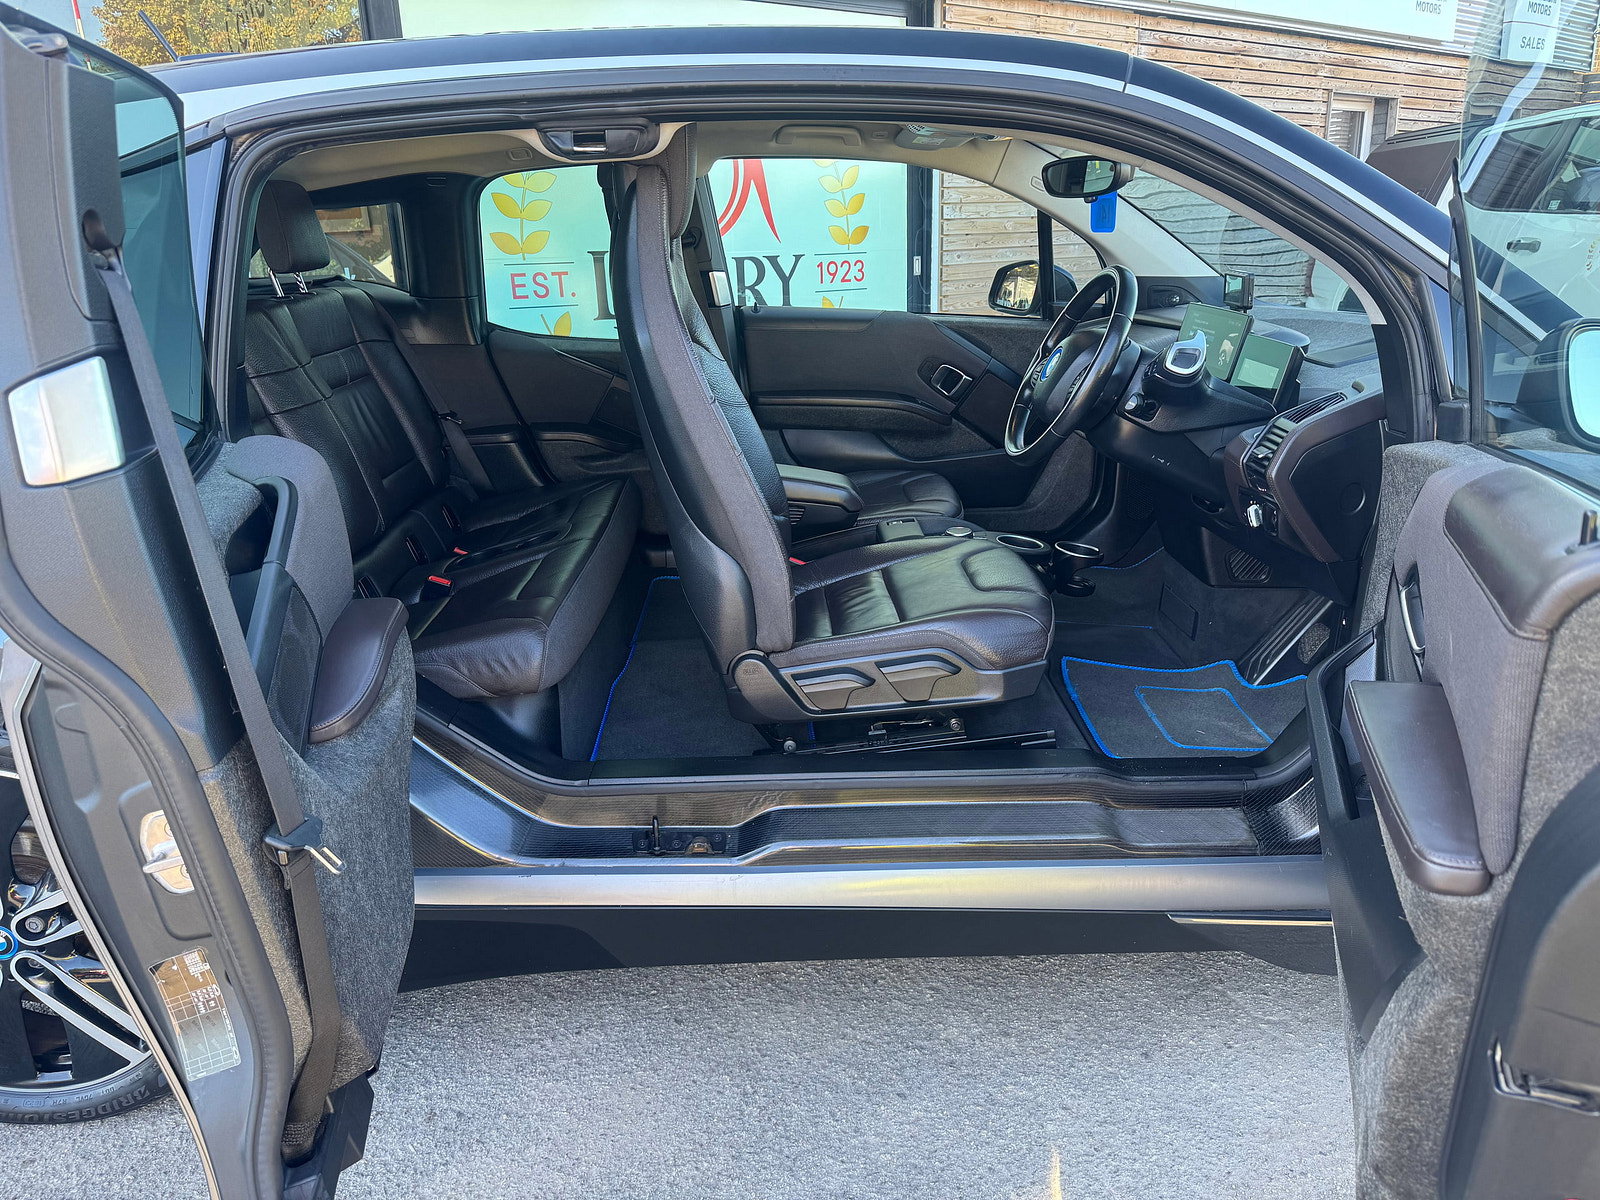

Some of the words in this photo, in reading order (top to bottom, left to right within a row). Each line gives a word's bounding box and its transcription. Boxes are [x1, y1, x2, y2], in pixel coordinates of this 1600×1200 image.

[1415, 0, 1442, 15] MOTORS
[1527, 1, 1552, 16] MOTORS
[1520, 36, 1546, 50] SALES
[816, 259, 865, 285] 1923
[510, 271, 577, 300] EST.
